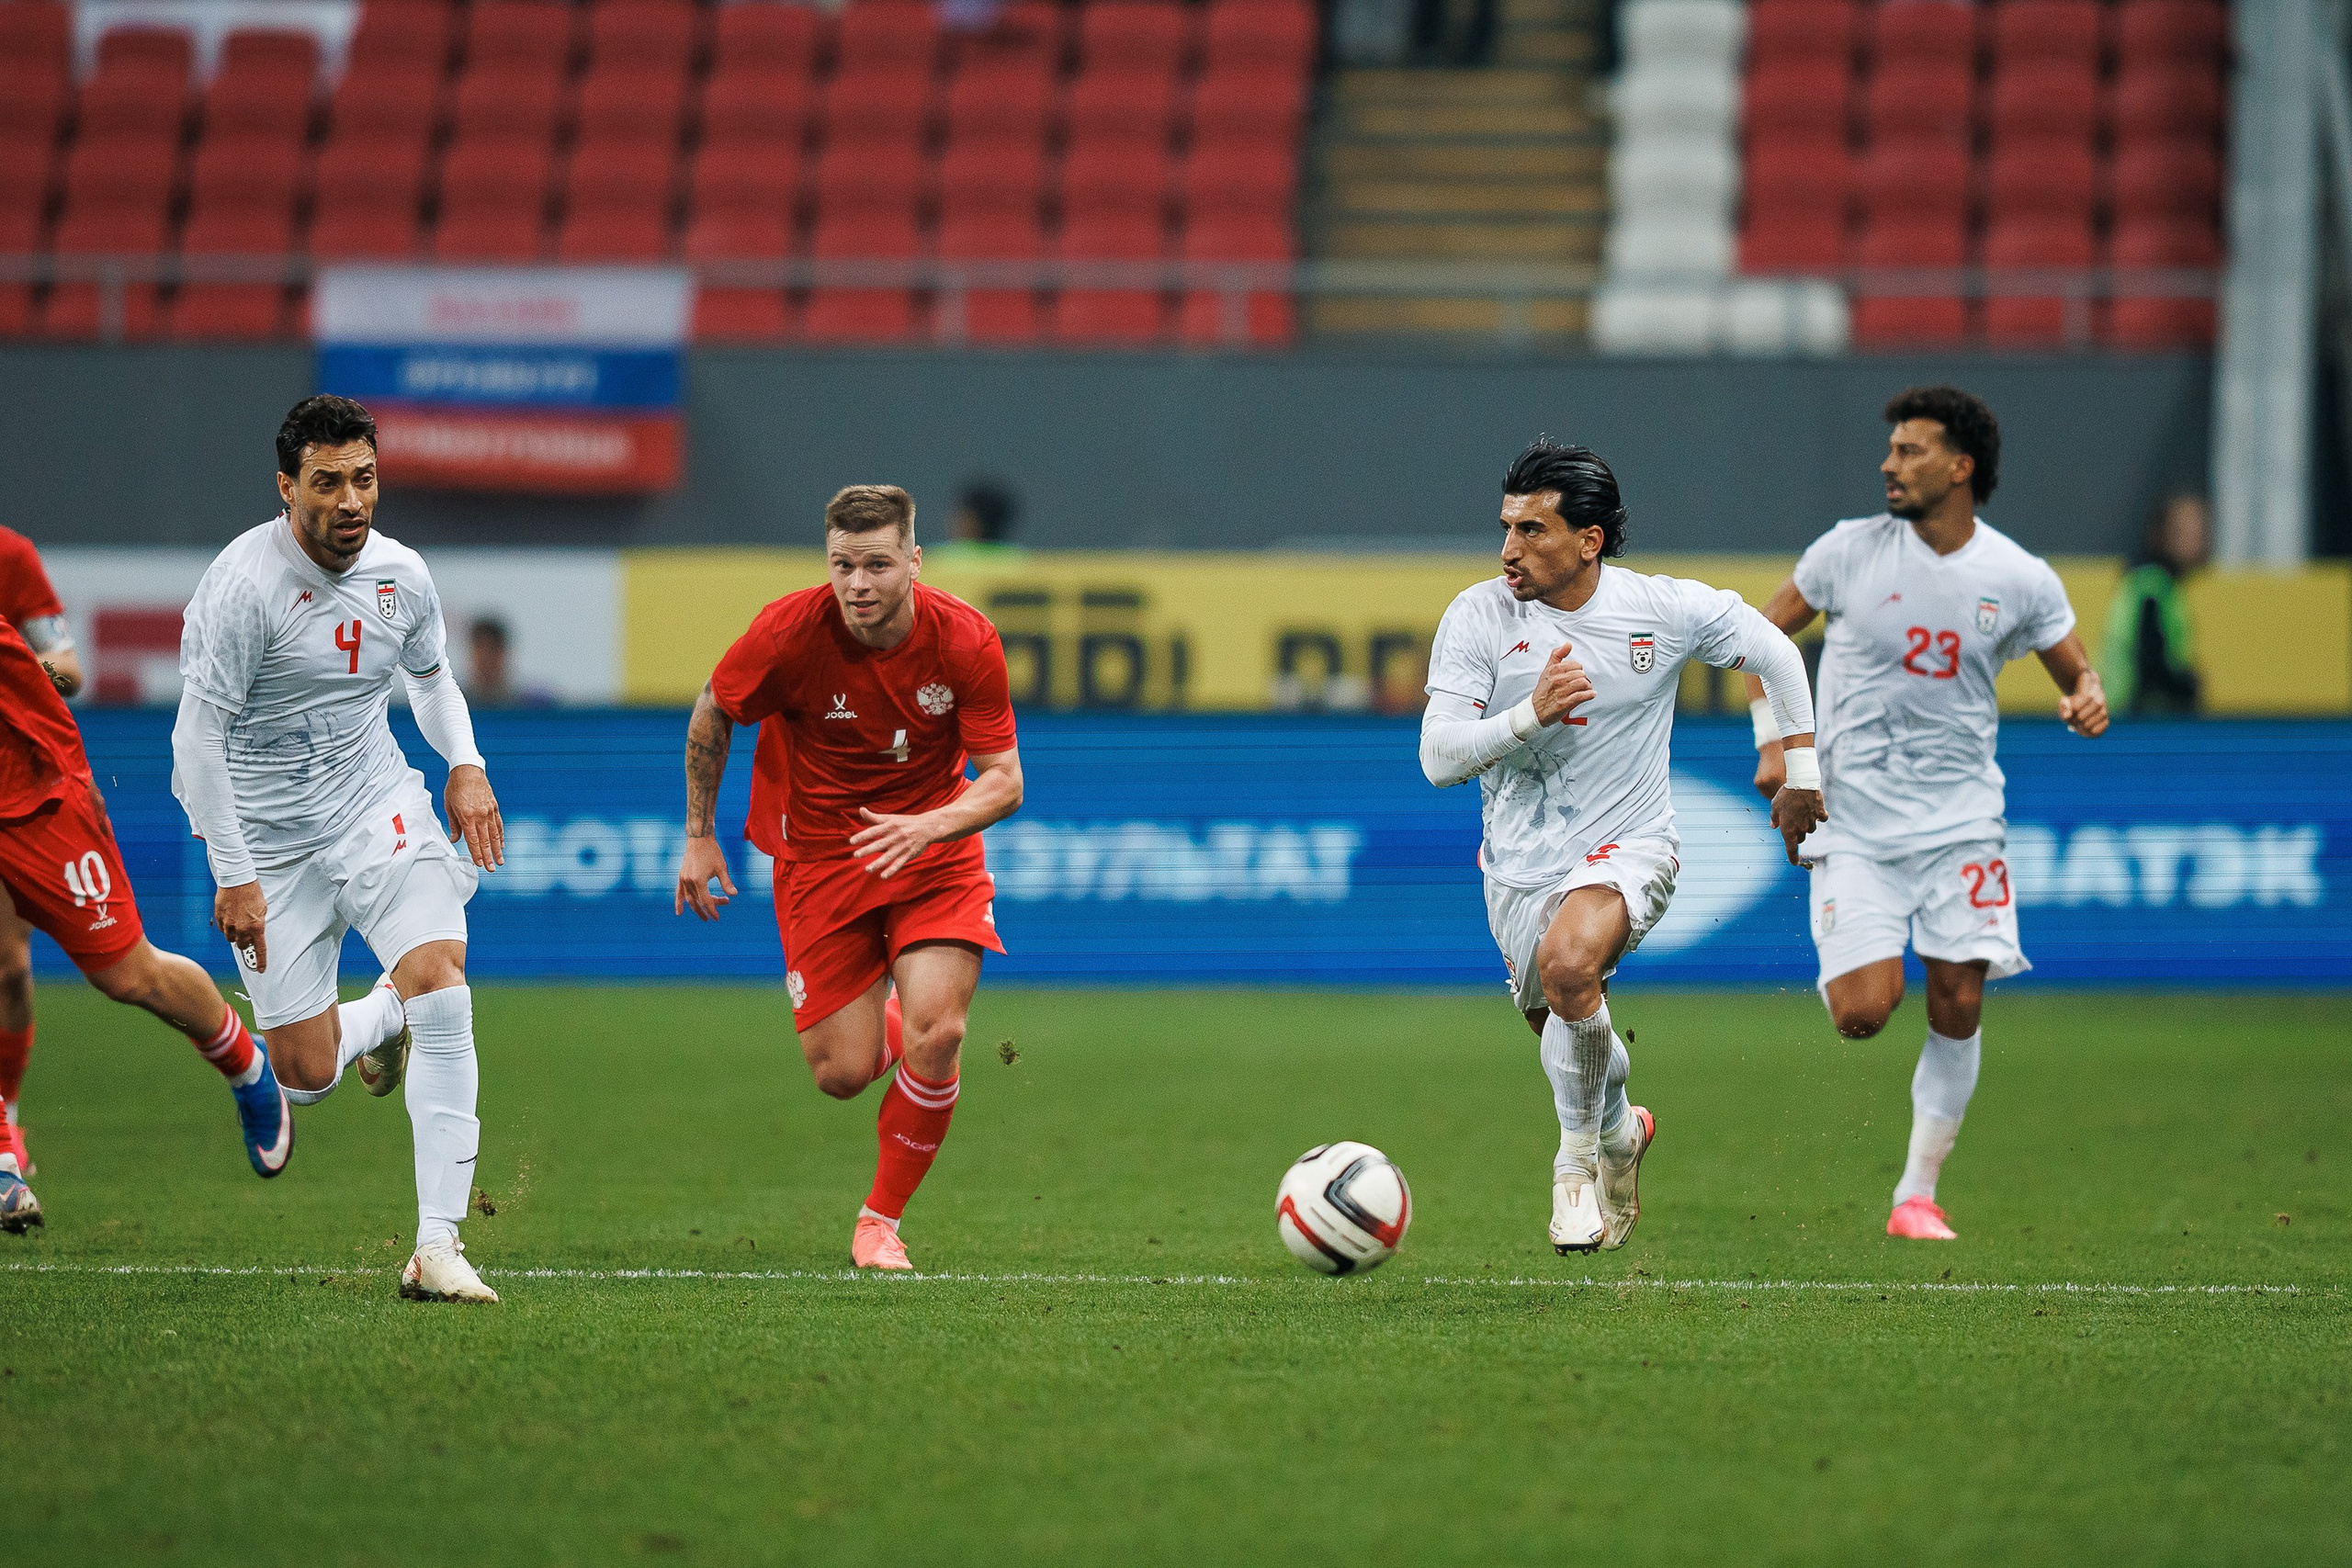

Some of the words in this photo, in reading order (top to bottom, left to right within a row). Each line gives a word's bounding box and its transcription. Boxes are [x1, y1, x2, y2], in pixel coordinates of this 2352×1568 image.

[334, 619, 362, 674] 4
[1902, 626, 1961, 680] 23
[825, 711, 858, 719] JOGEL
[63, 850, 111, 908] 10
[1960, 858, 2010, 908] 23
